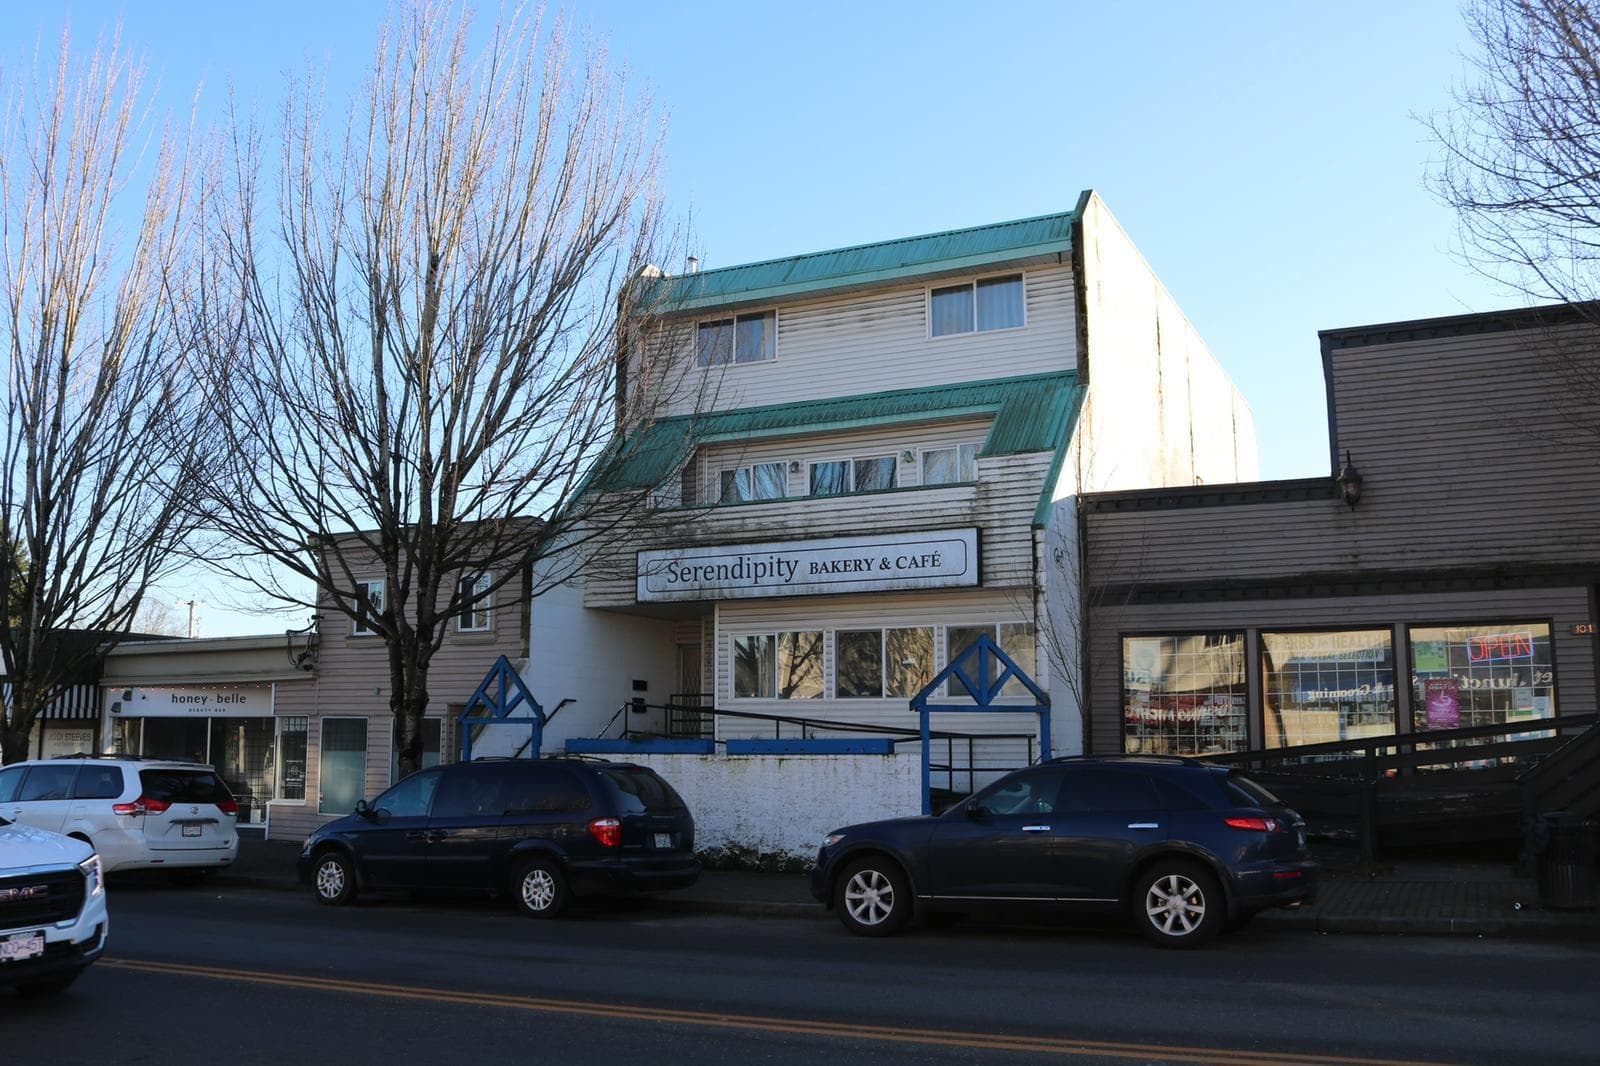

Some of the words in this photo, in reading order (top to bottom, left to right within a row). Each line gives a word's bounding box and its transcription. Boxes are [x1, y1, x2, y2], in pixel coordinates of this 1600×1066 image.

[667, 556, 799, 584] Serendipity
[808, 557, 875, 575] BAKERY
[879, 556, 893, 571] &
[895, 550, 942, 569] CAFÉ
[1575, 623, 1593, 634] 101
[1470, 634, 1531, 660] OPEN
[171, 693, 208, 705] honey
[216, 693, 247, 704] belle
